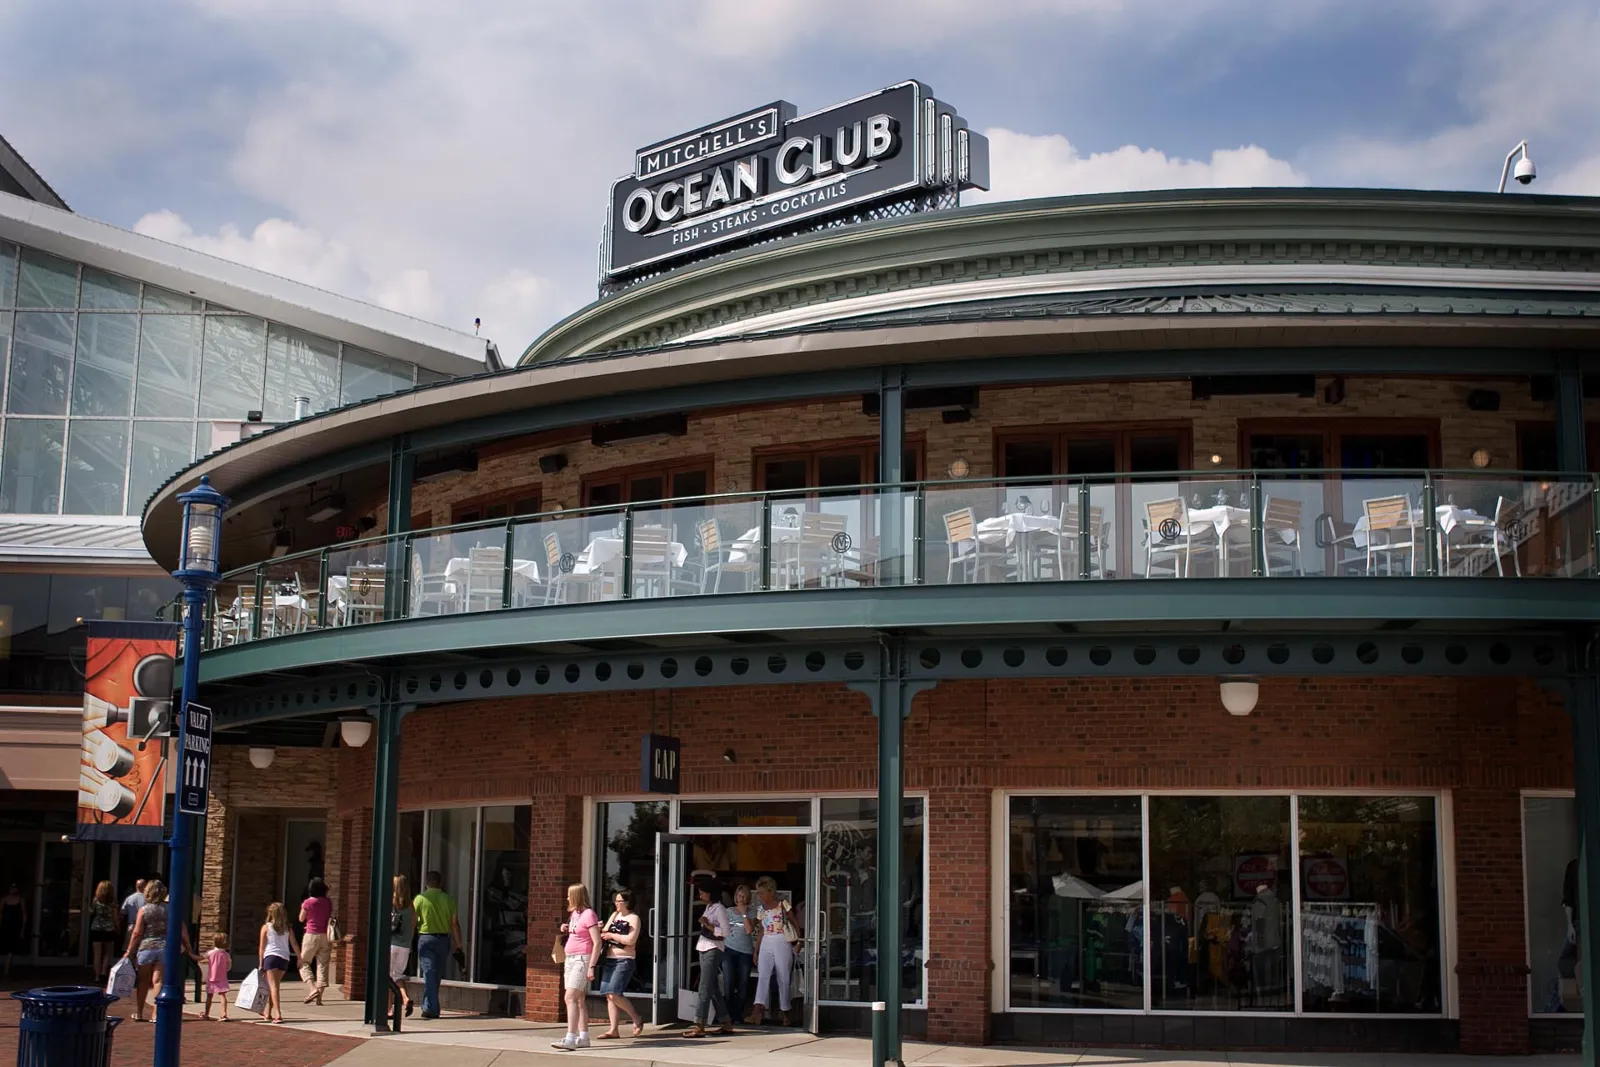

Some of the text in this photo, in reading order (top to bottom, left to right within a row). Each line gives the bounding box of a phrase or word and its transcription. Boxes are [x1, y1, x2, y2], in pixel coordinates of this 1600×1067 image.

[647, 120, 768, 173] MITCHELL'S
[622, 114, 897, 234] OCEAN CLUB
[672, 184, 848, 246] FISH STEAKS COCKTAILS
[190, 710, 208, 730] VALET
[184, 733, 210, 754] PARKING
[654, 748, 676, 781] GAP
